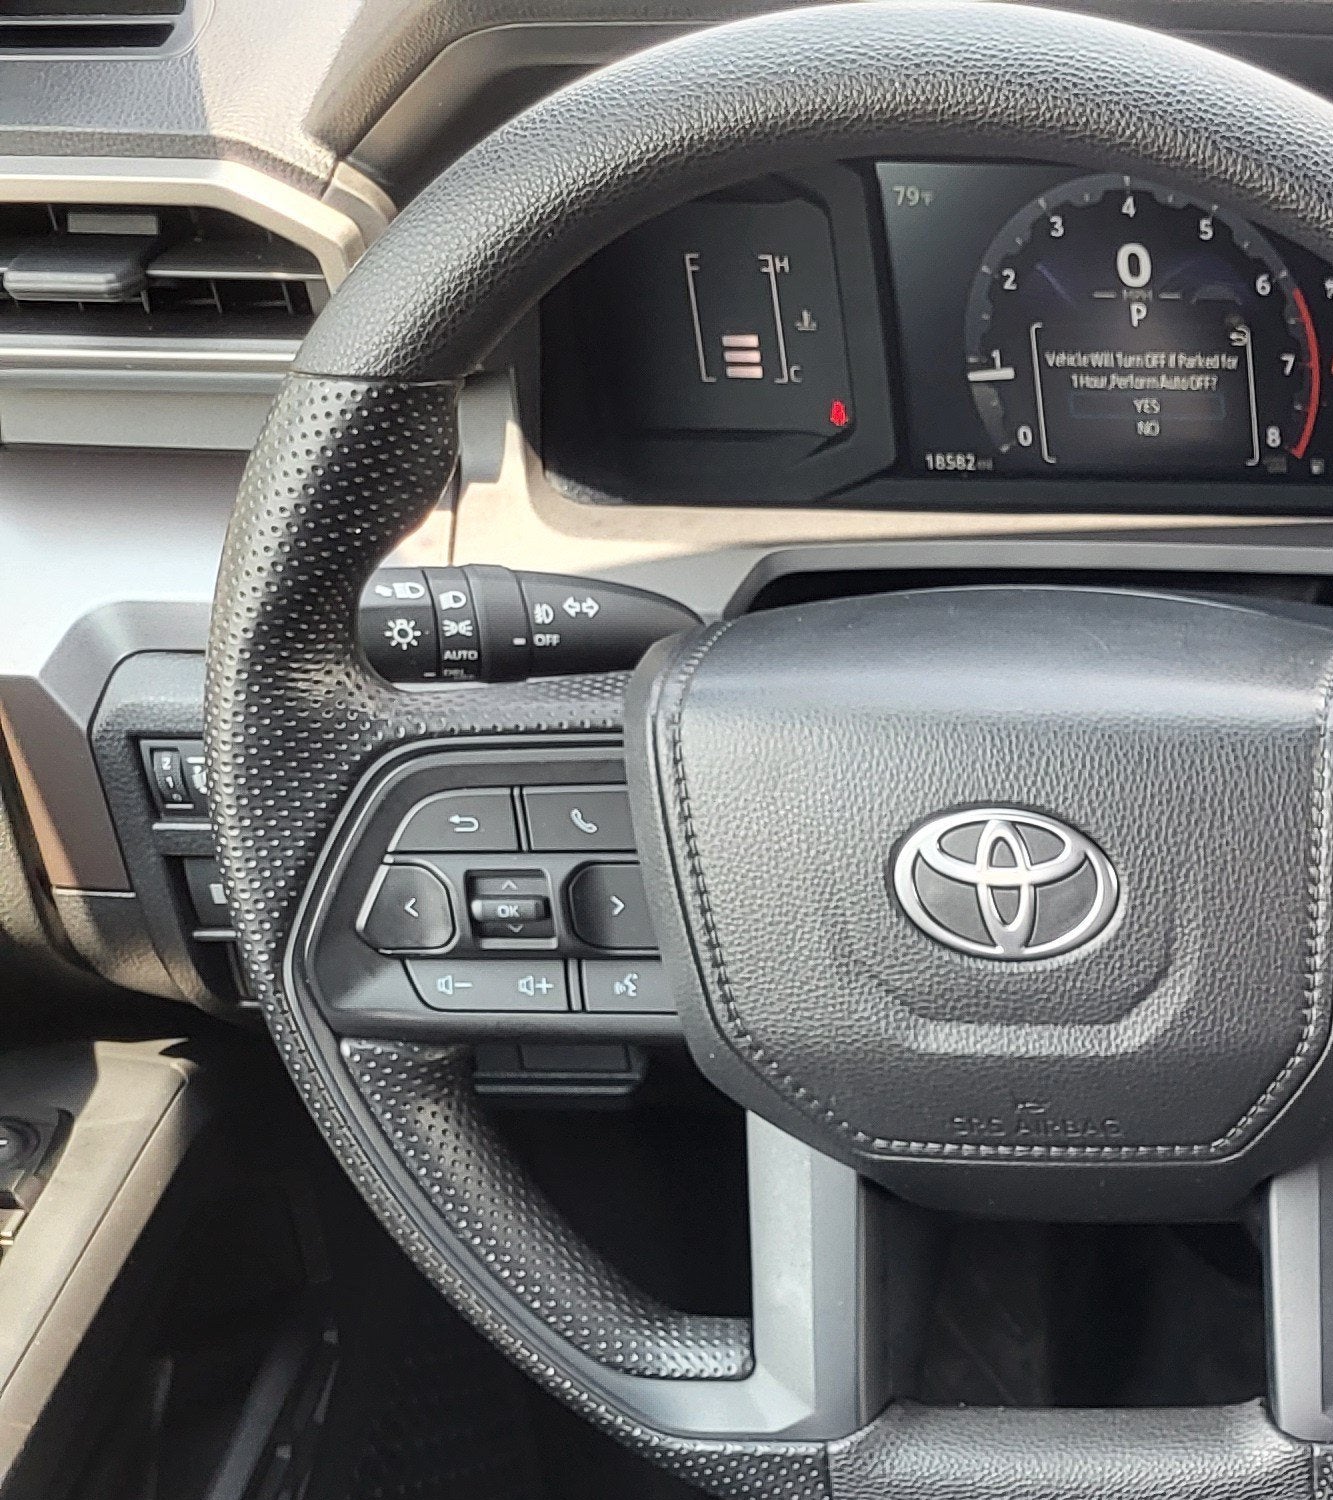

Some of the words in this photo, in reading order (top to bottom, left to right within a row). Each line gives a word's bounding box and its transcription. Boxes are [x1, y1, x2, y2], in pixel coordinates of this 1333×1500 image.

[1122, 196, 1136, 218] 4
[1050, 216, 1064, 237] 3
[1199, 218, 1214, 240] 5
[1116, 242, 1152, 288] 0
[1002, 268, 1017, 291] 2
[1255, 274, 1270, 296] 6
[1130, 302, 1147, 328] P
[1280, 353, 1295, 376] 7
[1133, 398, 1161, 414] YES
[1017, 425, 1033, 447] 0
[1137, 420, 1161, 436] NO
[1266, 425, 1281, 448] 8
[925, 453, 976, 471] 18582
[533, 633, 561, 647] OFF
[443, 650, 479, 661] AUTO
[497, 904, 520, 918] OK
